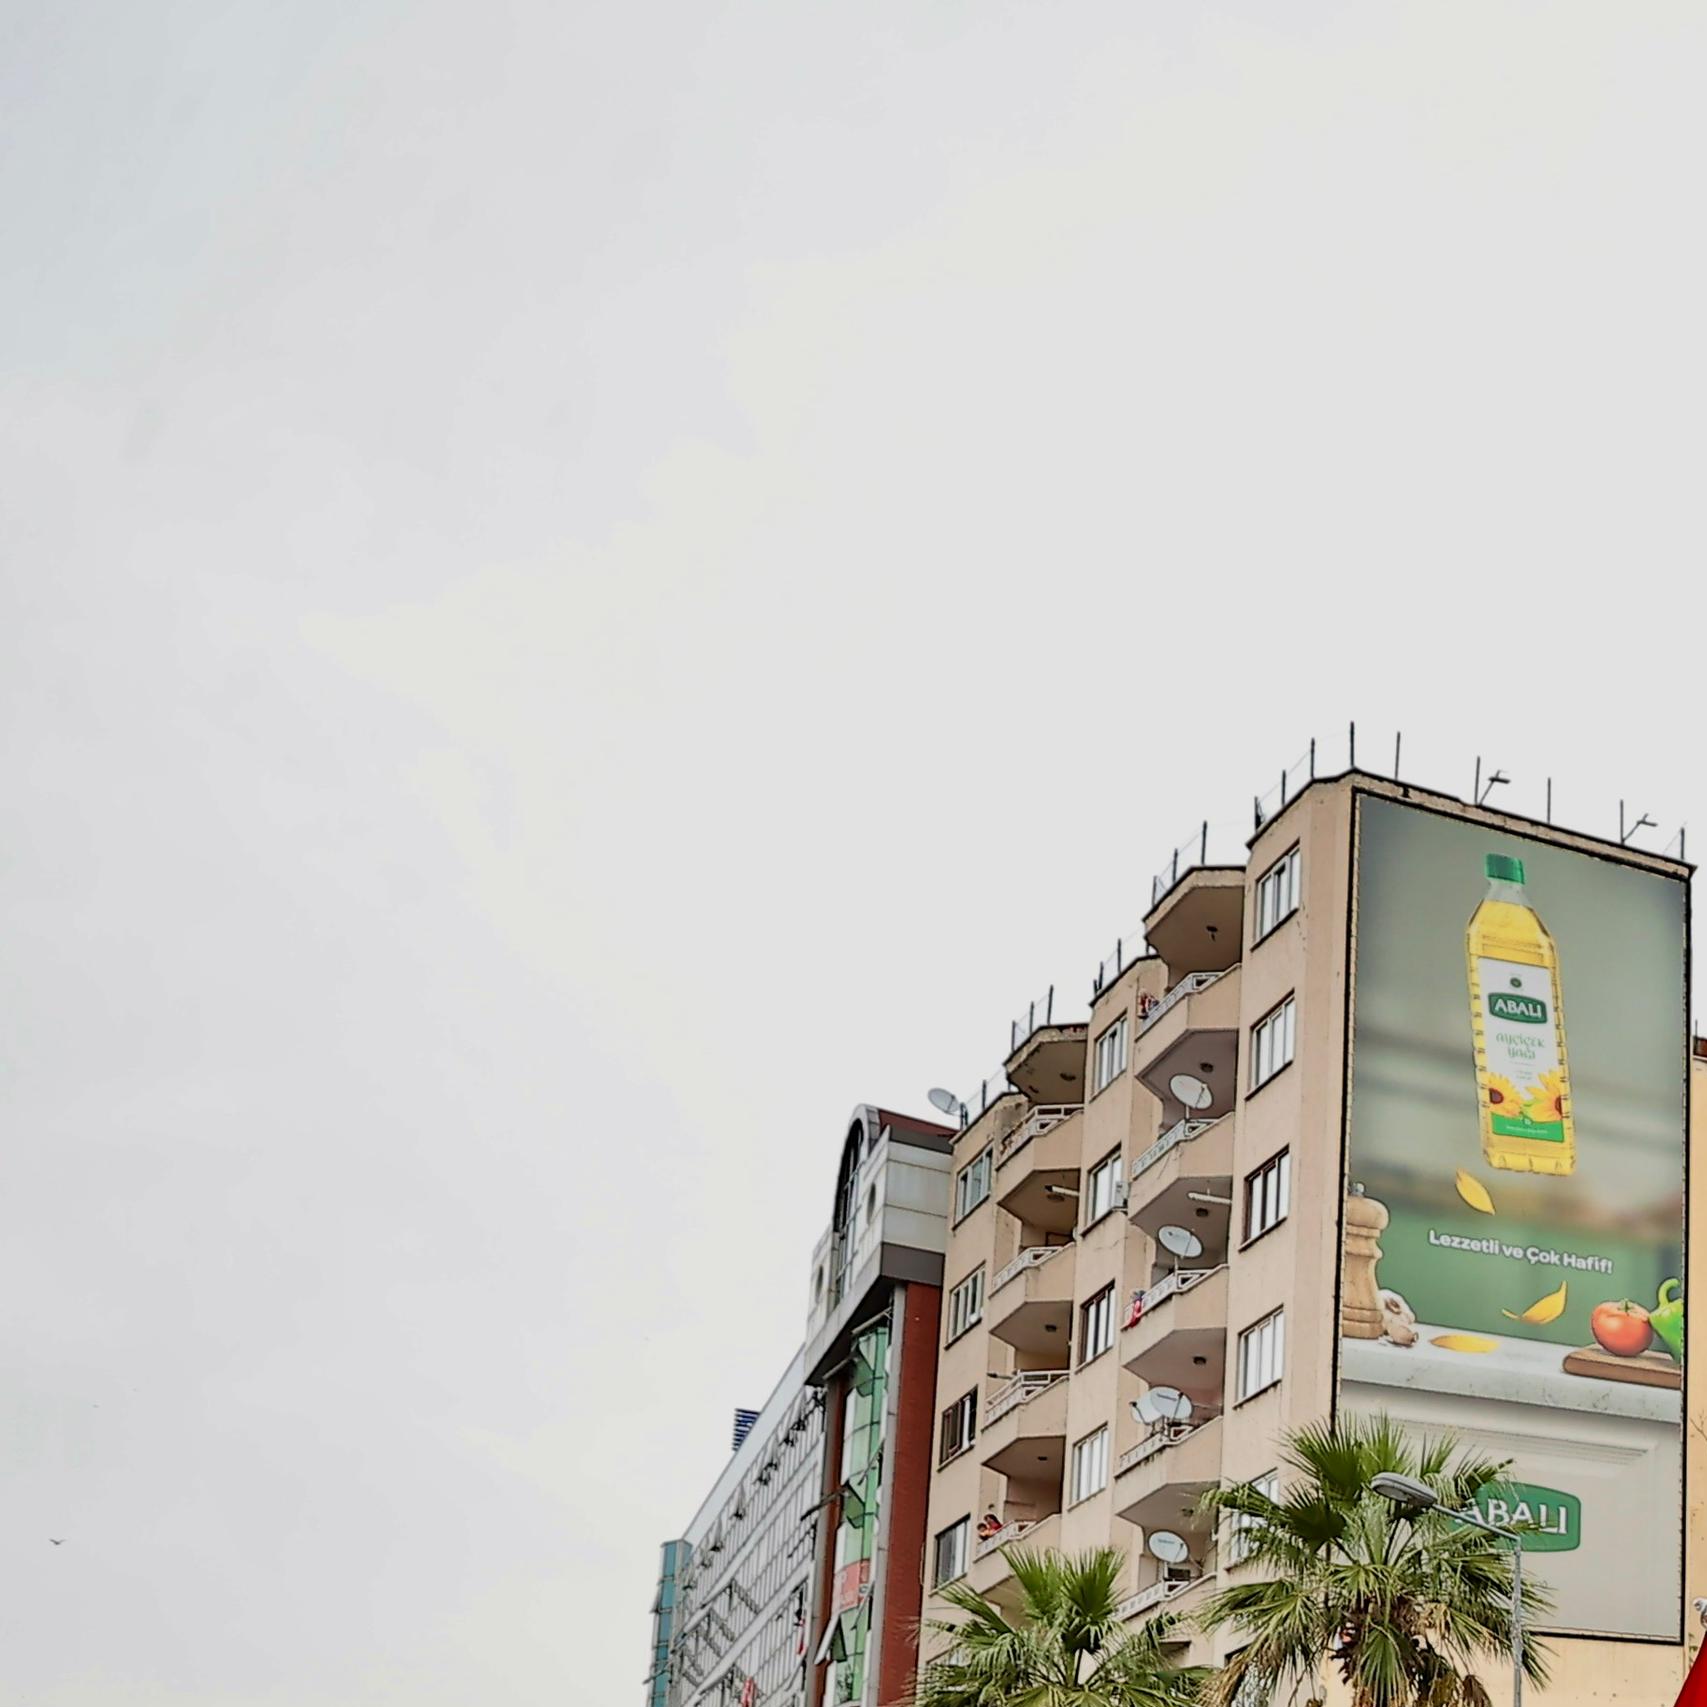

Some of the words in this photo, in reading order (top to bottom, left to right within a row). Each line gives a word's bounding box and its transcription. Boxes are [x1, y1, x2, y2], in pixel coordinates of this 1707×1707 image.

[1494, 998, 1543, 1019] ABALI
[1428, 1229, 1500, 1256] Lezzetli
[1502, 1244, 1524, 1259] ve
[1526, 1246, 1561, 1265] Çok
[1562, 1252, 1613, 1275] Hafif!
